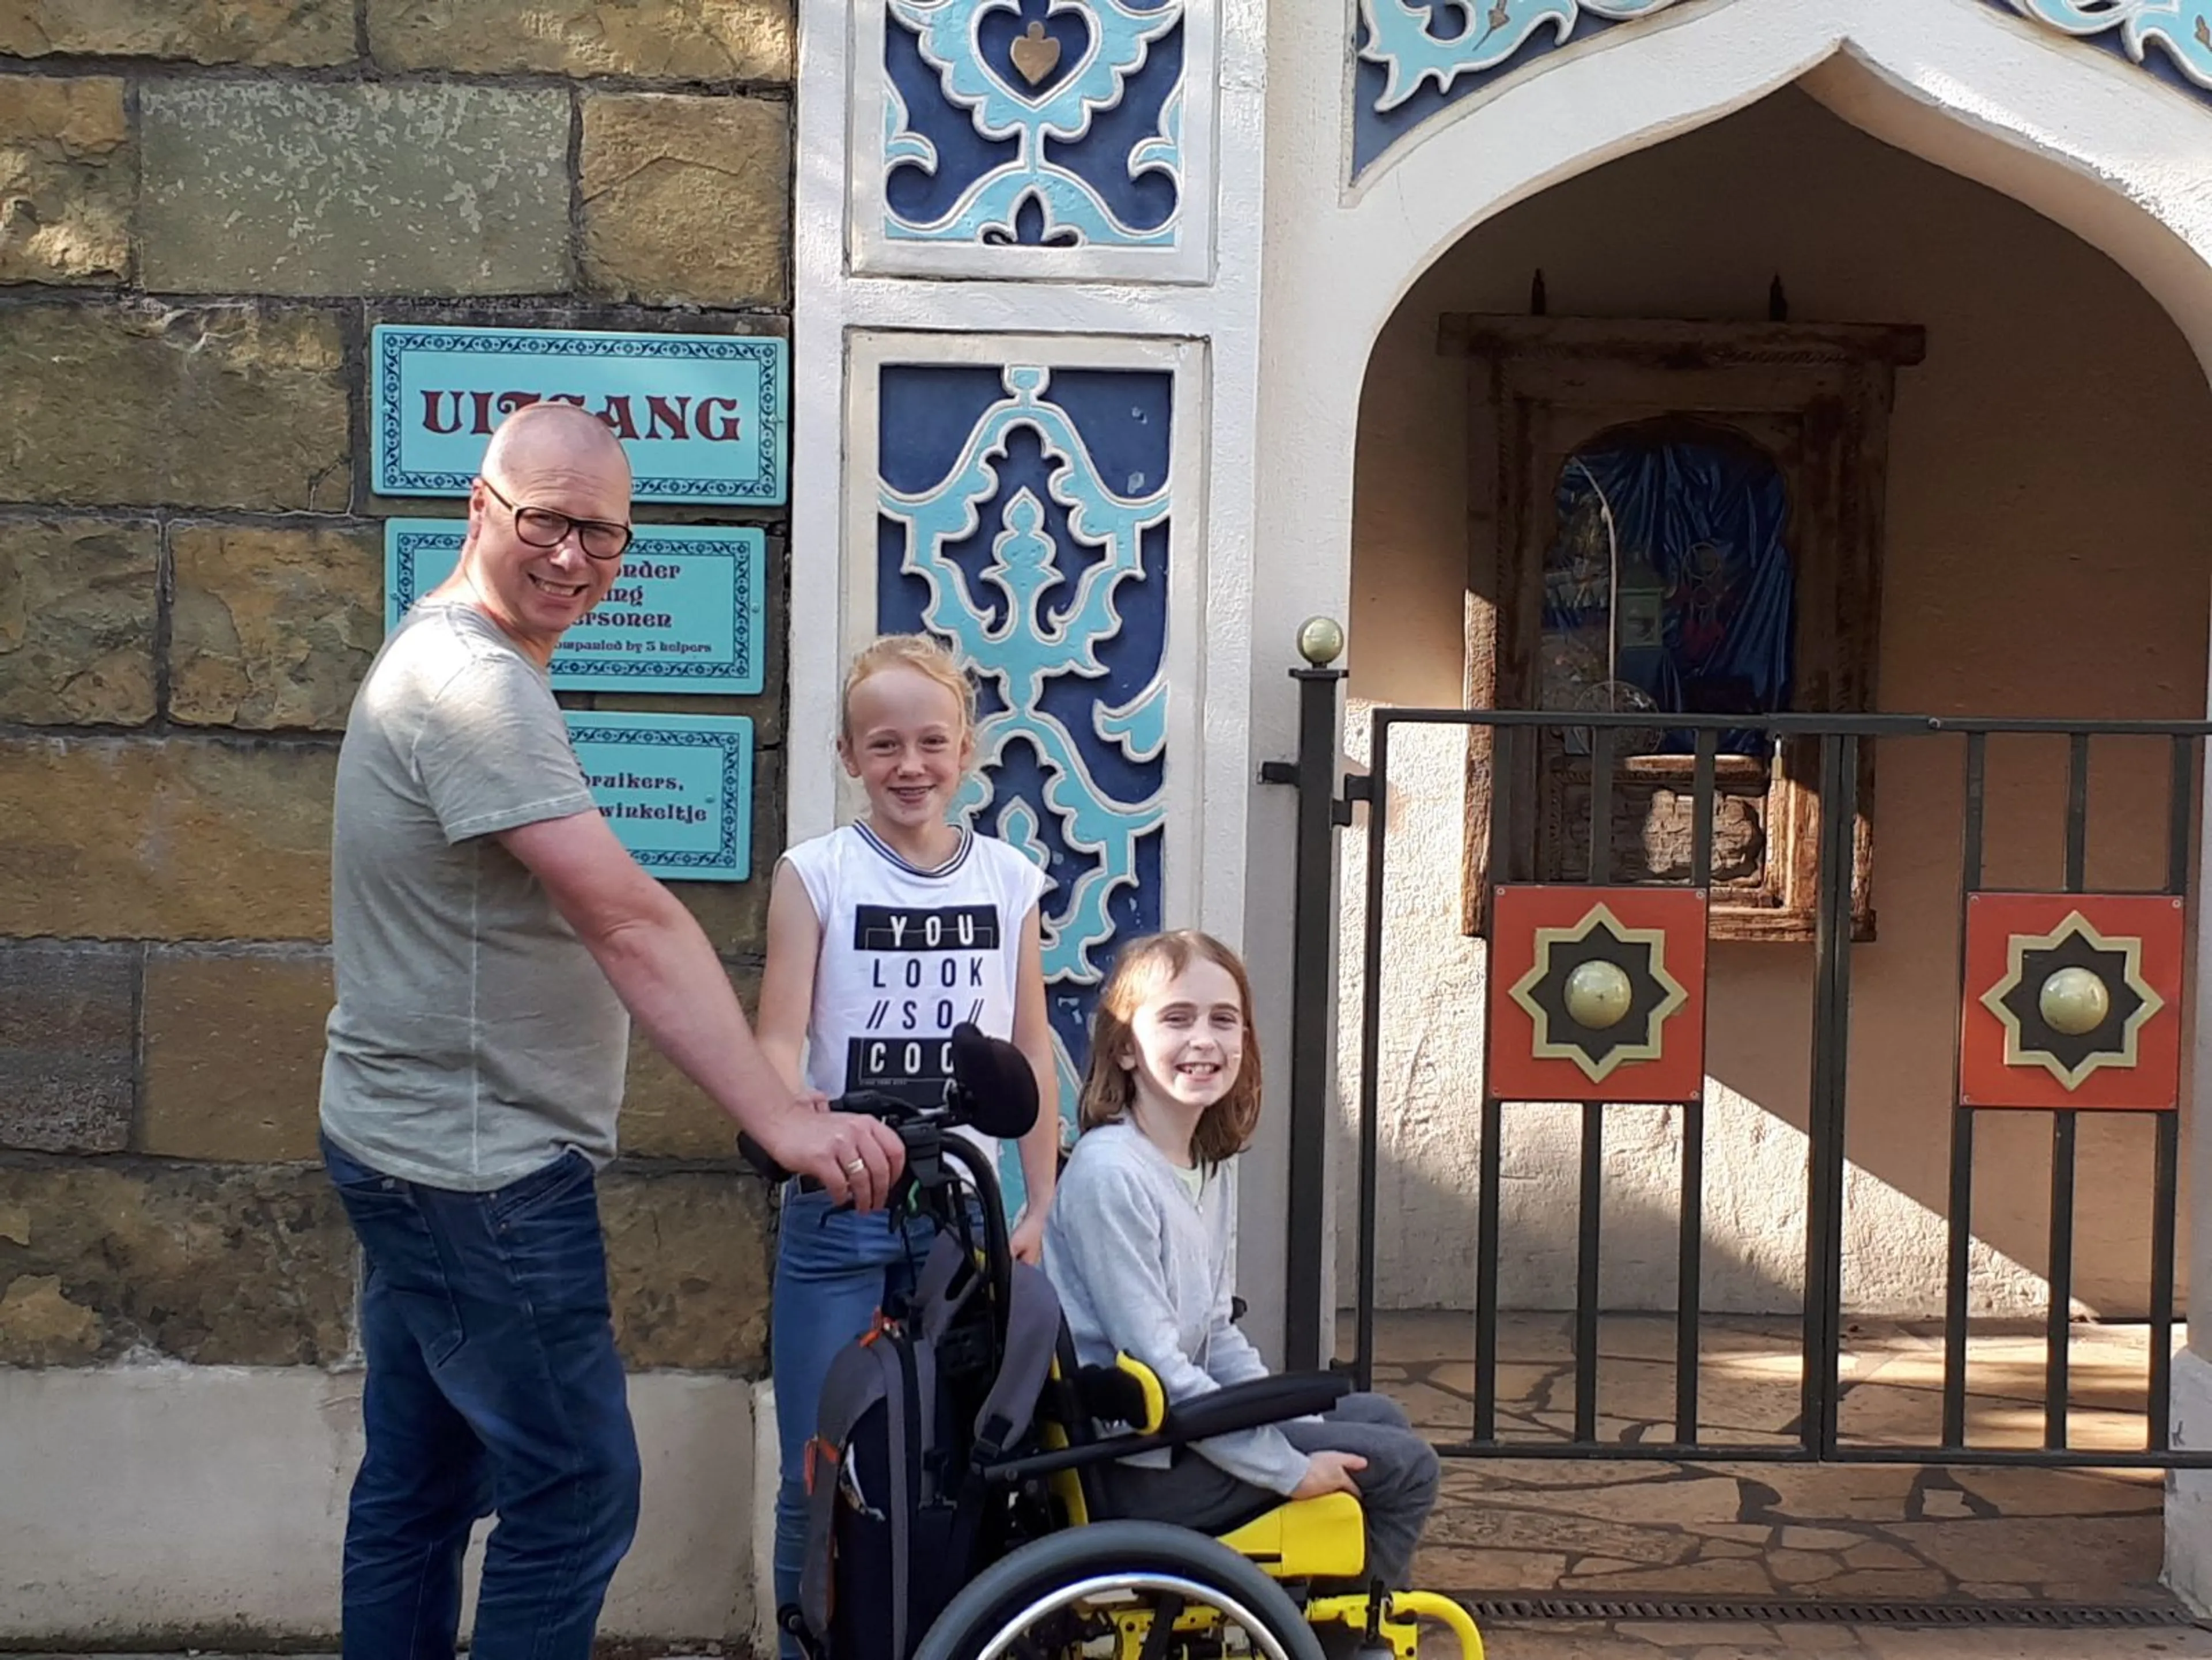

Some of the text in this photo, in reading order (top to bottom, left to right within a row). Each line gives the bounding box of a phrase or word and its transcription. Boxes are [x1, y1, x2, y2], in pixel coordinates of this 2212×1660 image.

[420, 389, 741, 442] UITANG
[571, 611, 672, 628] ersonen
[554, 640, 622, 653] ompanied
[626, 640, 642, 653] by
[660, 641, 712, 654] helpers
[890, 915, 974, 948] YOU
[873, 957, 983, 988] LOOK
[870, 1041, 955, 1075] COO
